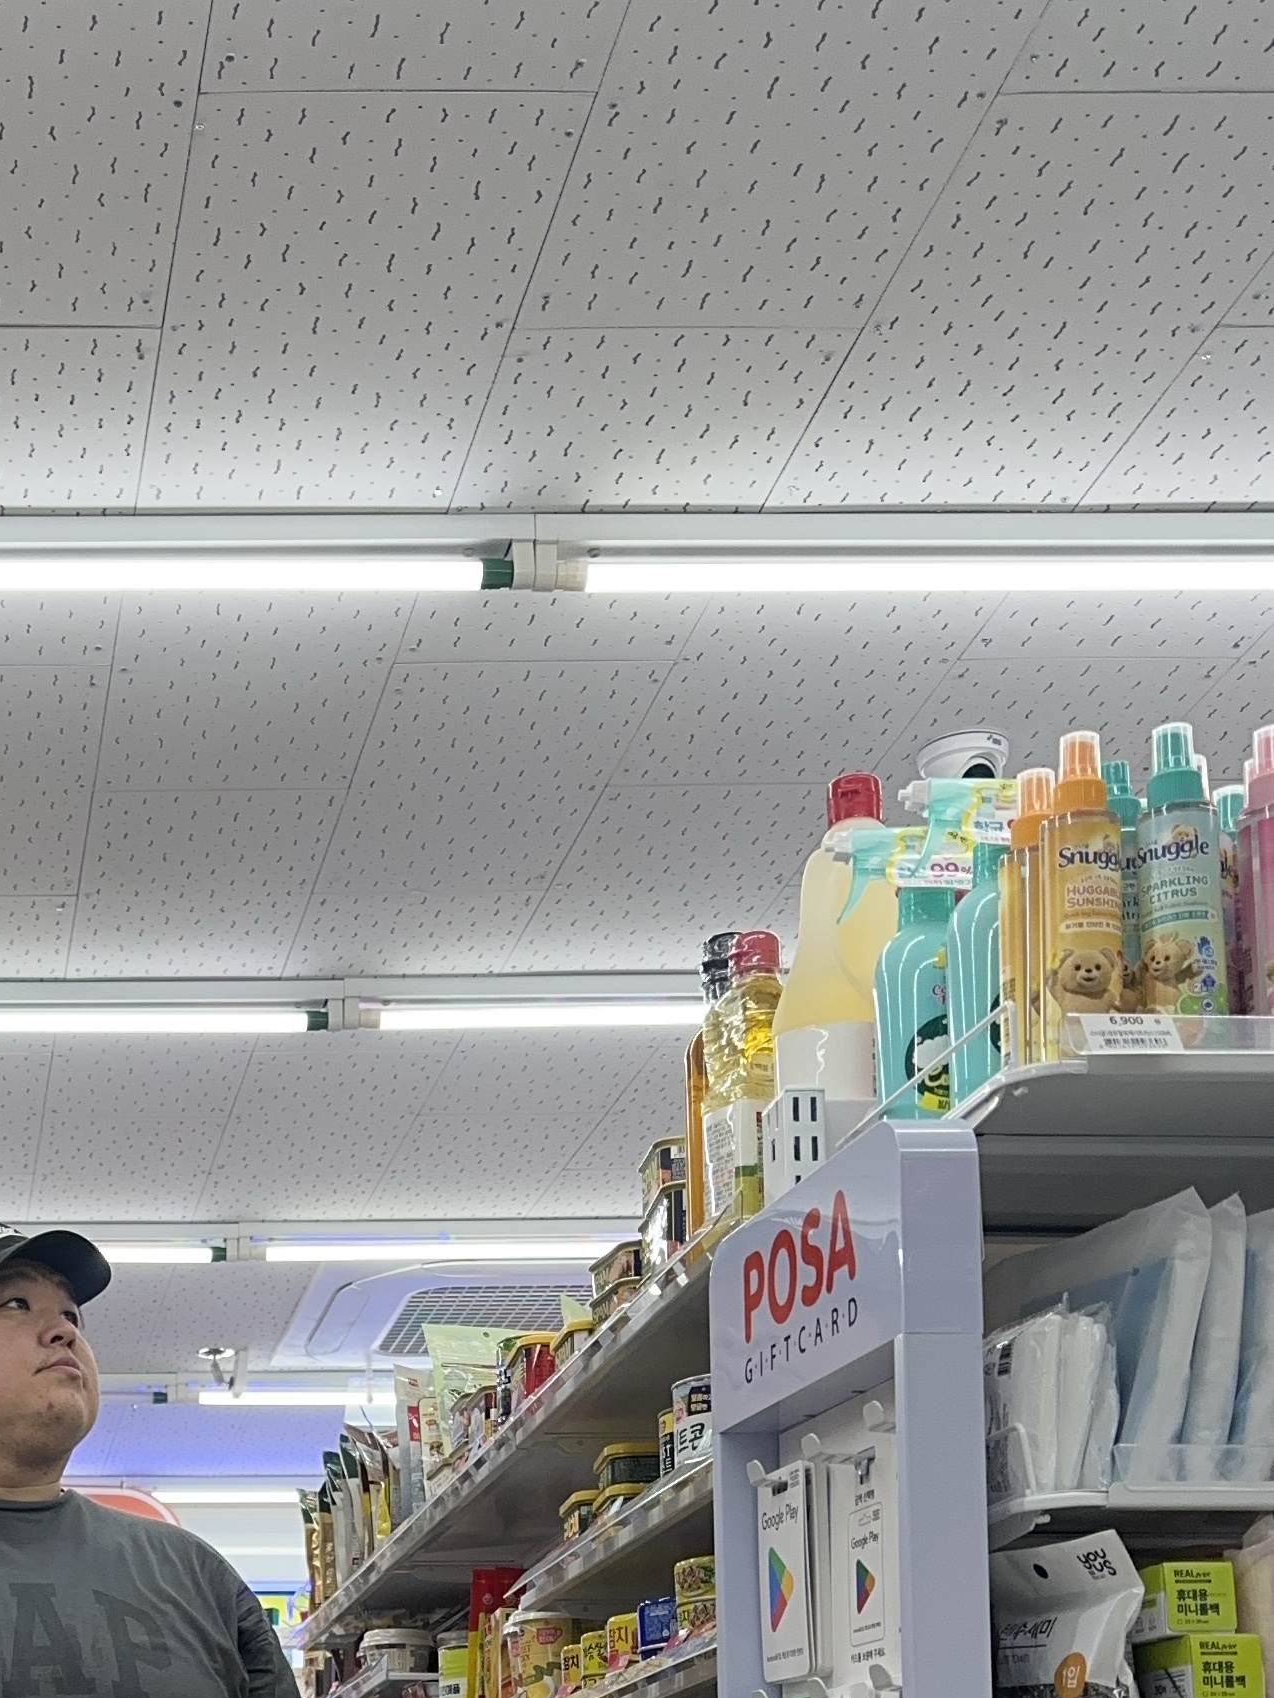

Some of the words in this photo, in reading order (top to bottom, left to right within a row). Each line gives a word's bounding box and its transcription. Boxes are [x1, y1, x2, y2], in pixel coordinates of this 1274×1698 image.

[1058, 846, 1122, 872] Snugg
[1137, 835, 1209, 868] Snuggle
[1067, 885, 1122, 899] HUGGABL
[1141, 876, 1209, 899] SPARKLING
[1149, 887, 1198, 905] CITRUS
[743, 1190, 856, 1343] POSA
[762, 1508, 784, 1531] Google
[786, 1504, 799, 1524] Play
[851, 1535, 868, 1550] Google
[1177, 1589, 1208, 1602] 휴대용
[1202, 1660, 1234, 1673] 휴대용
